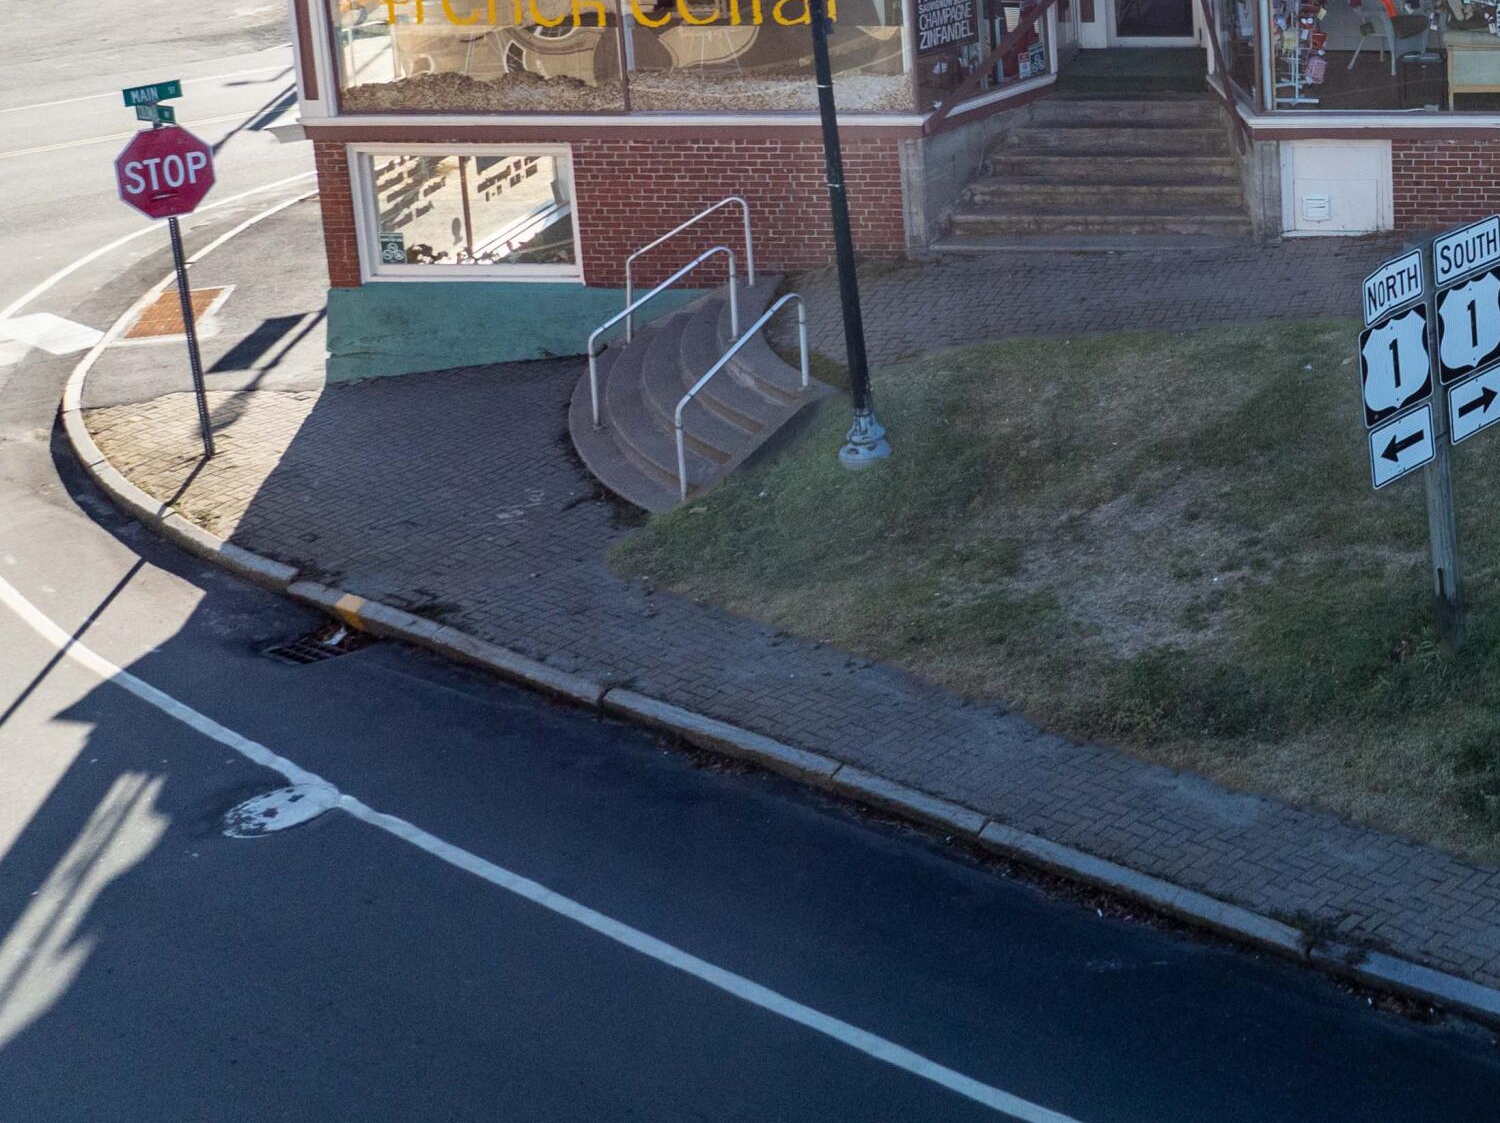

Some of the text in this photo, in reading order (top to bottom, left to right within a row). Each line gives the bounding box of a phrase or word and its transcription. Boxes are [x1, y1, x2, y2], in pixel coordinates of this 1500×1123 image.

[918, 1, 972, 31] CHAMPAGNE
[919, 19, 974, 50] ZINFANDEL
[130, 87, 159, 103] MAIN
[124, 151, 207, 194] STOP
[1440, 229, 1498, 275] SOUTH
[1367, 264, 1419, 317] NORTH
[1467, 299, 1478, 348] 1
[1388, 338, 1401, 389] 1
